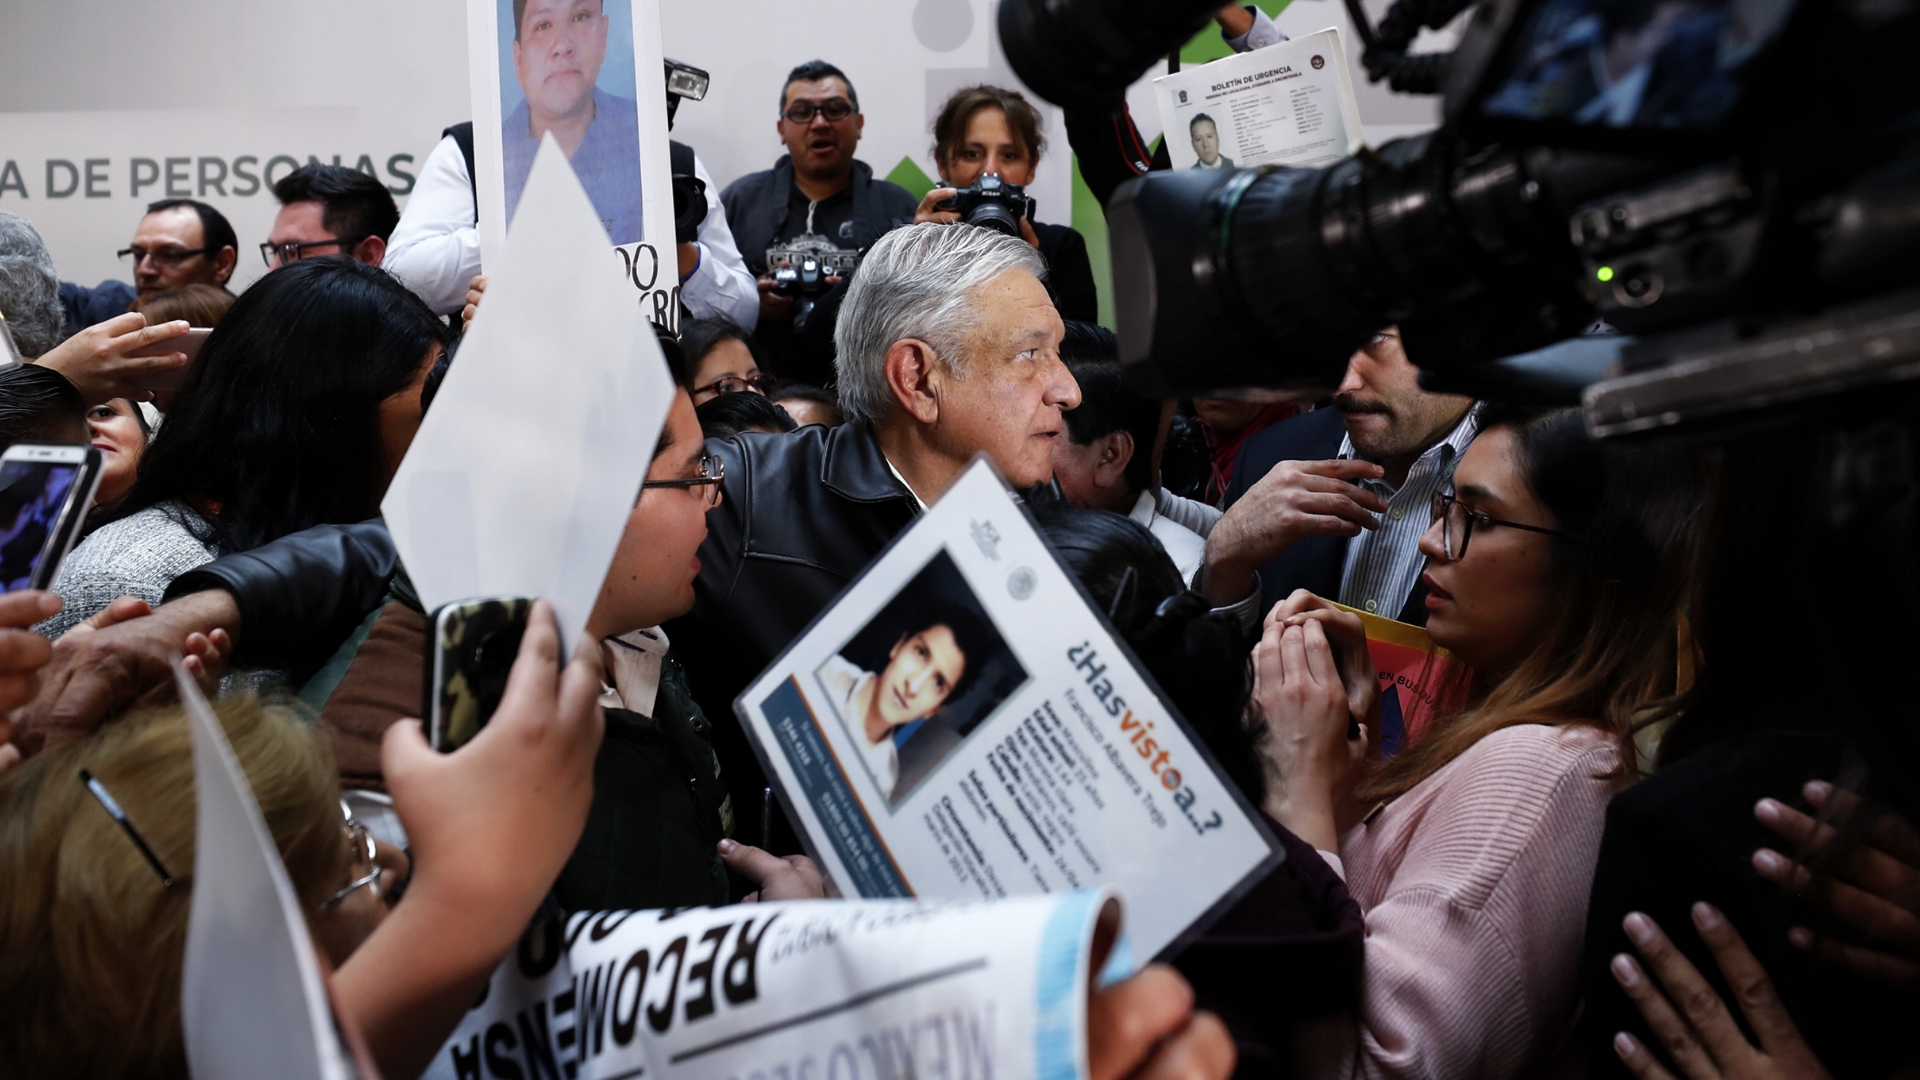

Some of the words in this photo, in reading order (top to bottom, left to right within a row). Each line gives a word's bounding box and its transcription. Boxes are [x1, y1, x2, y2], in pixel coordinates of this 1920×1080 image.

[1211, 78, 1243, 92] BOLETÍN
[1243, 75, 1253, 84] DE
[1254, 65, 1292, 81] URGENCIA
[0, 160, 28, 199] A
[45, 159, 111, 198] DE
[130, 154, 416, 197] PERSOAS
[1379, 671, 1395, 681] EN
